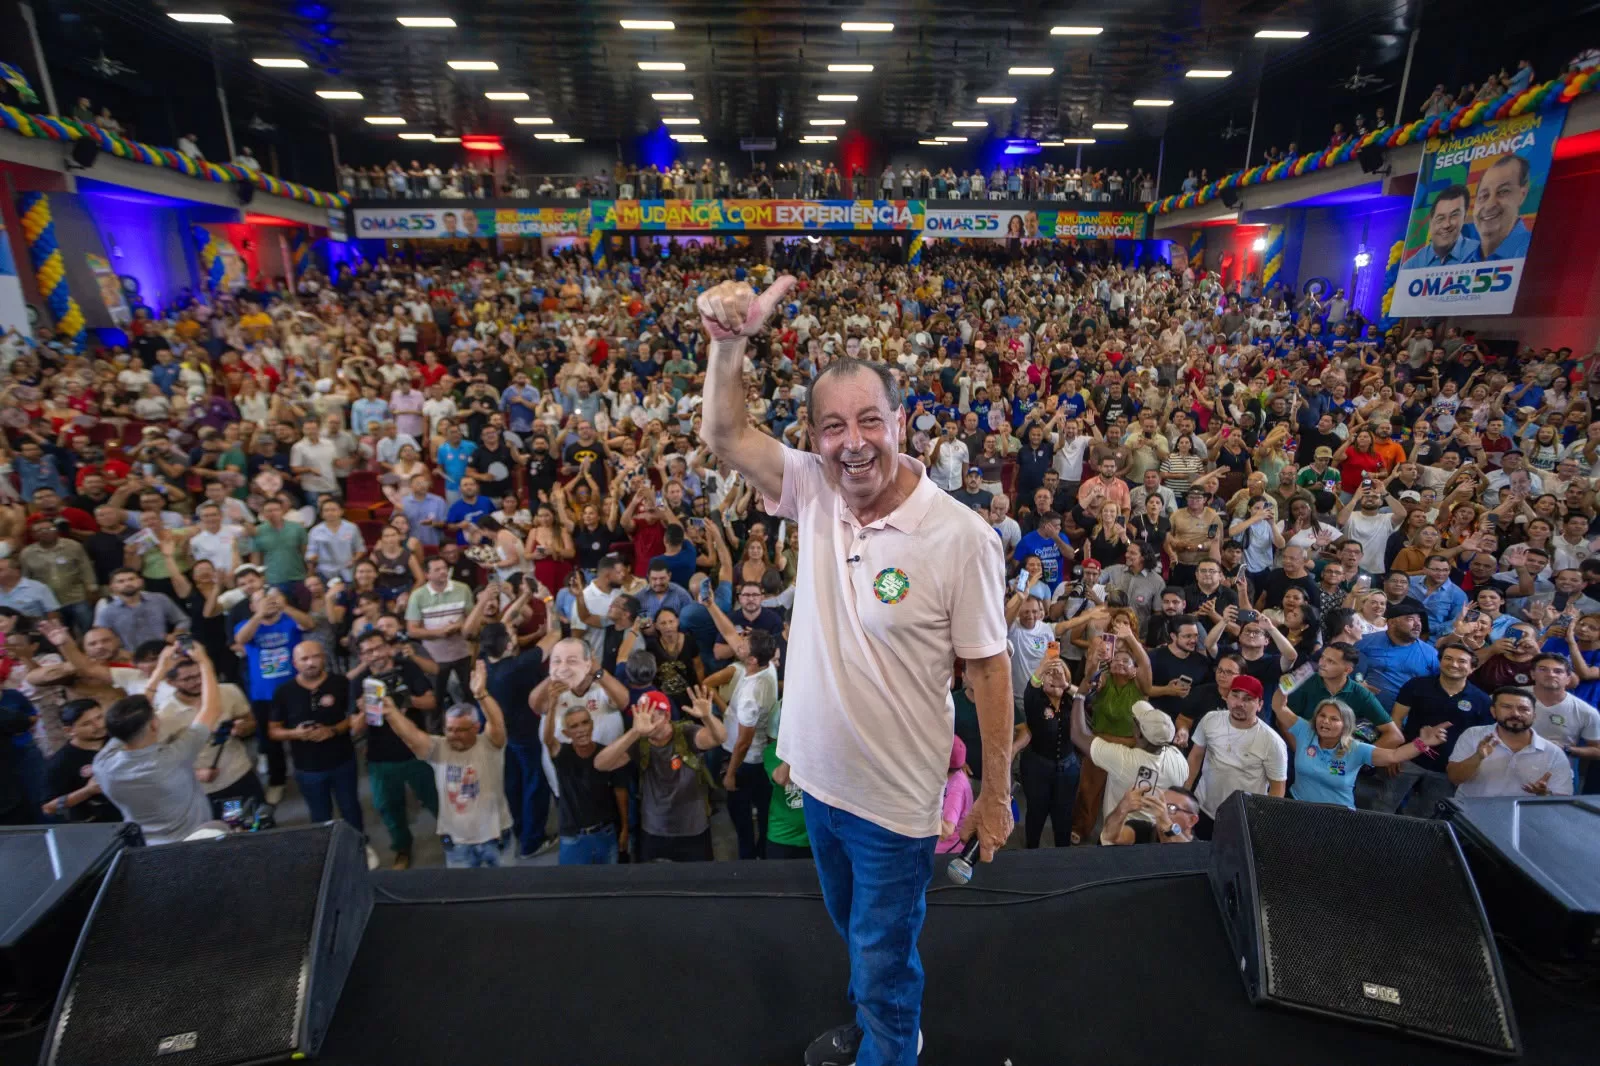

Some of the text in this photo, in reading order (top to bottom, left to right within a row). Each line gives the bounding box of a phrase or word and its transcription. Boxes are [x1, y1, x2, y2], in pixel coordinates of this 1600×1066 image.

[1434, 132, 1535, 169] SEGURANÇA
[604, 203, 914, 225] A MUDANÇA COM EXPERIÊNCIA
[1056, 215, 1062, 225] A
[1112, 215, 1134, 225] COM
[495, 222, 578, 234] SEGURANÇA
[1055, 225, 1131, 238] SEGURANÇA
